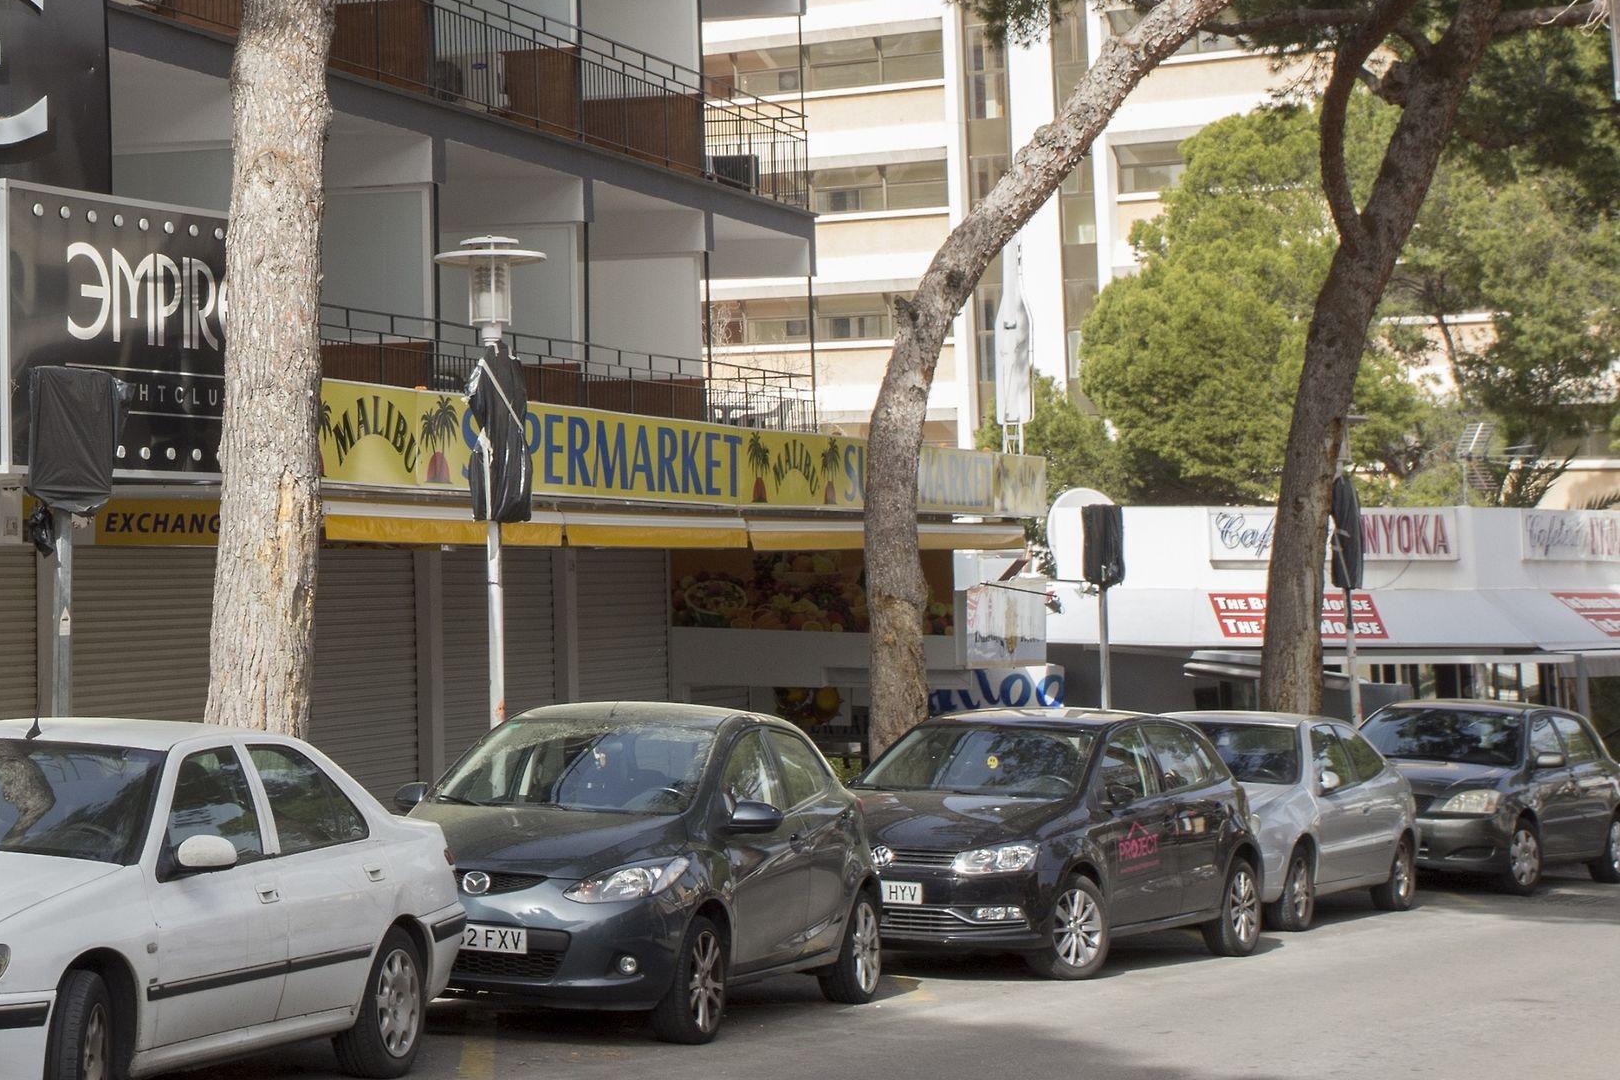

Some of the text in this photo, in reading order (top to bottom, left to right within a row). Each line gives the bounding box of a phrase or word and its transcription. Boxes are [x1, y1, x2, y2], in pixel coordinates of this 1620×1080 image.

[333, 395, 421, 473] MALIBU
[773, 439, 819, 497] MALIBU
[105, 512, 221, 534] EXCHANG
[1222, 618, 1262, 634] THE
[1119, 833, 1159, 861] PROJECT
[889, 885, 917, 901] HYV
[485, 929, 521, 950] FXV
